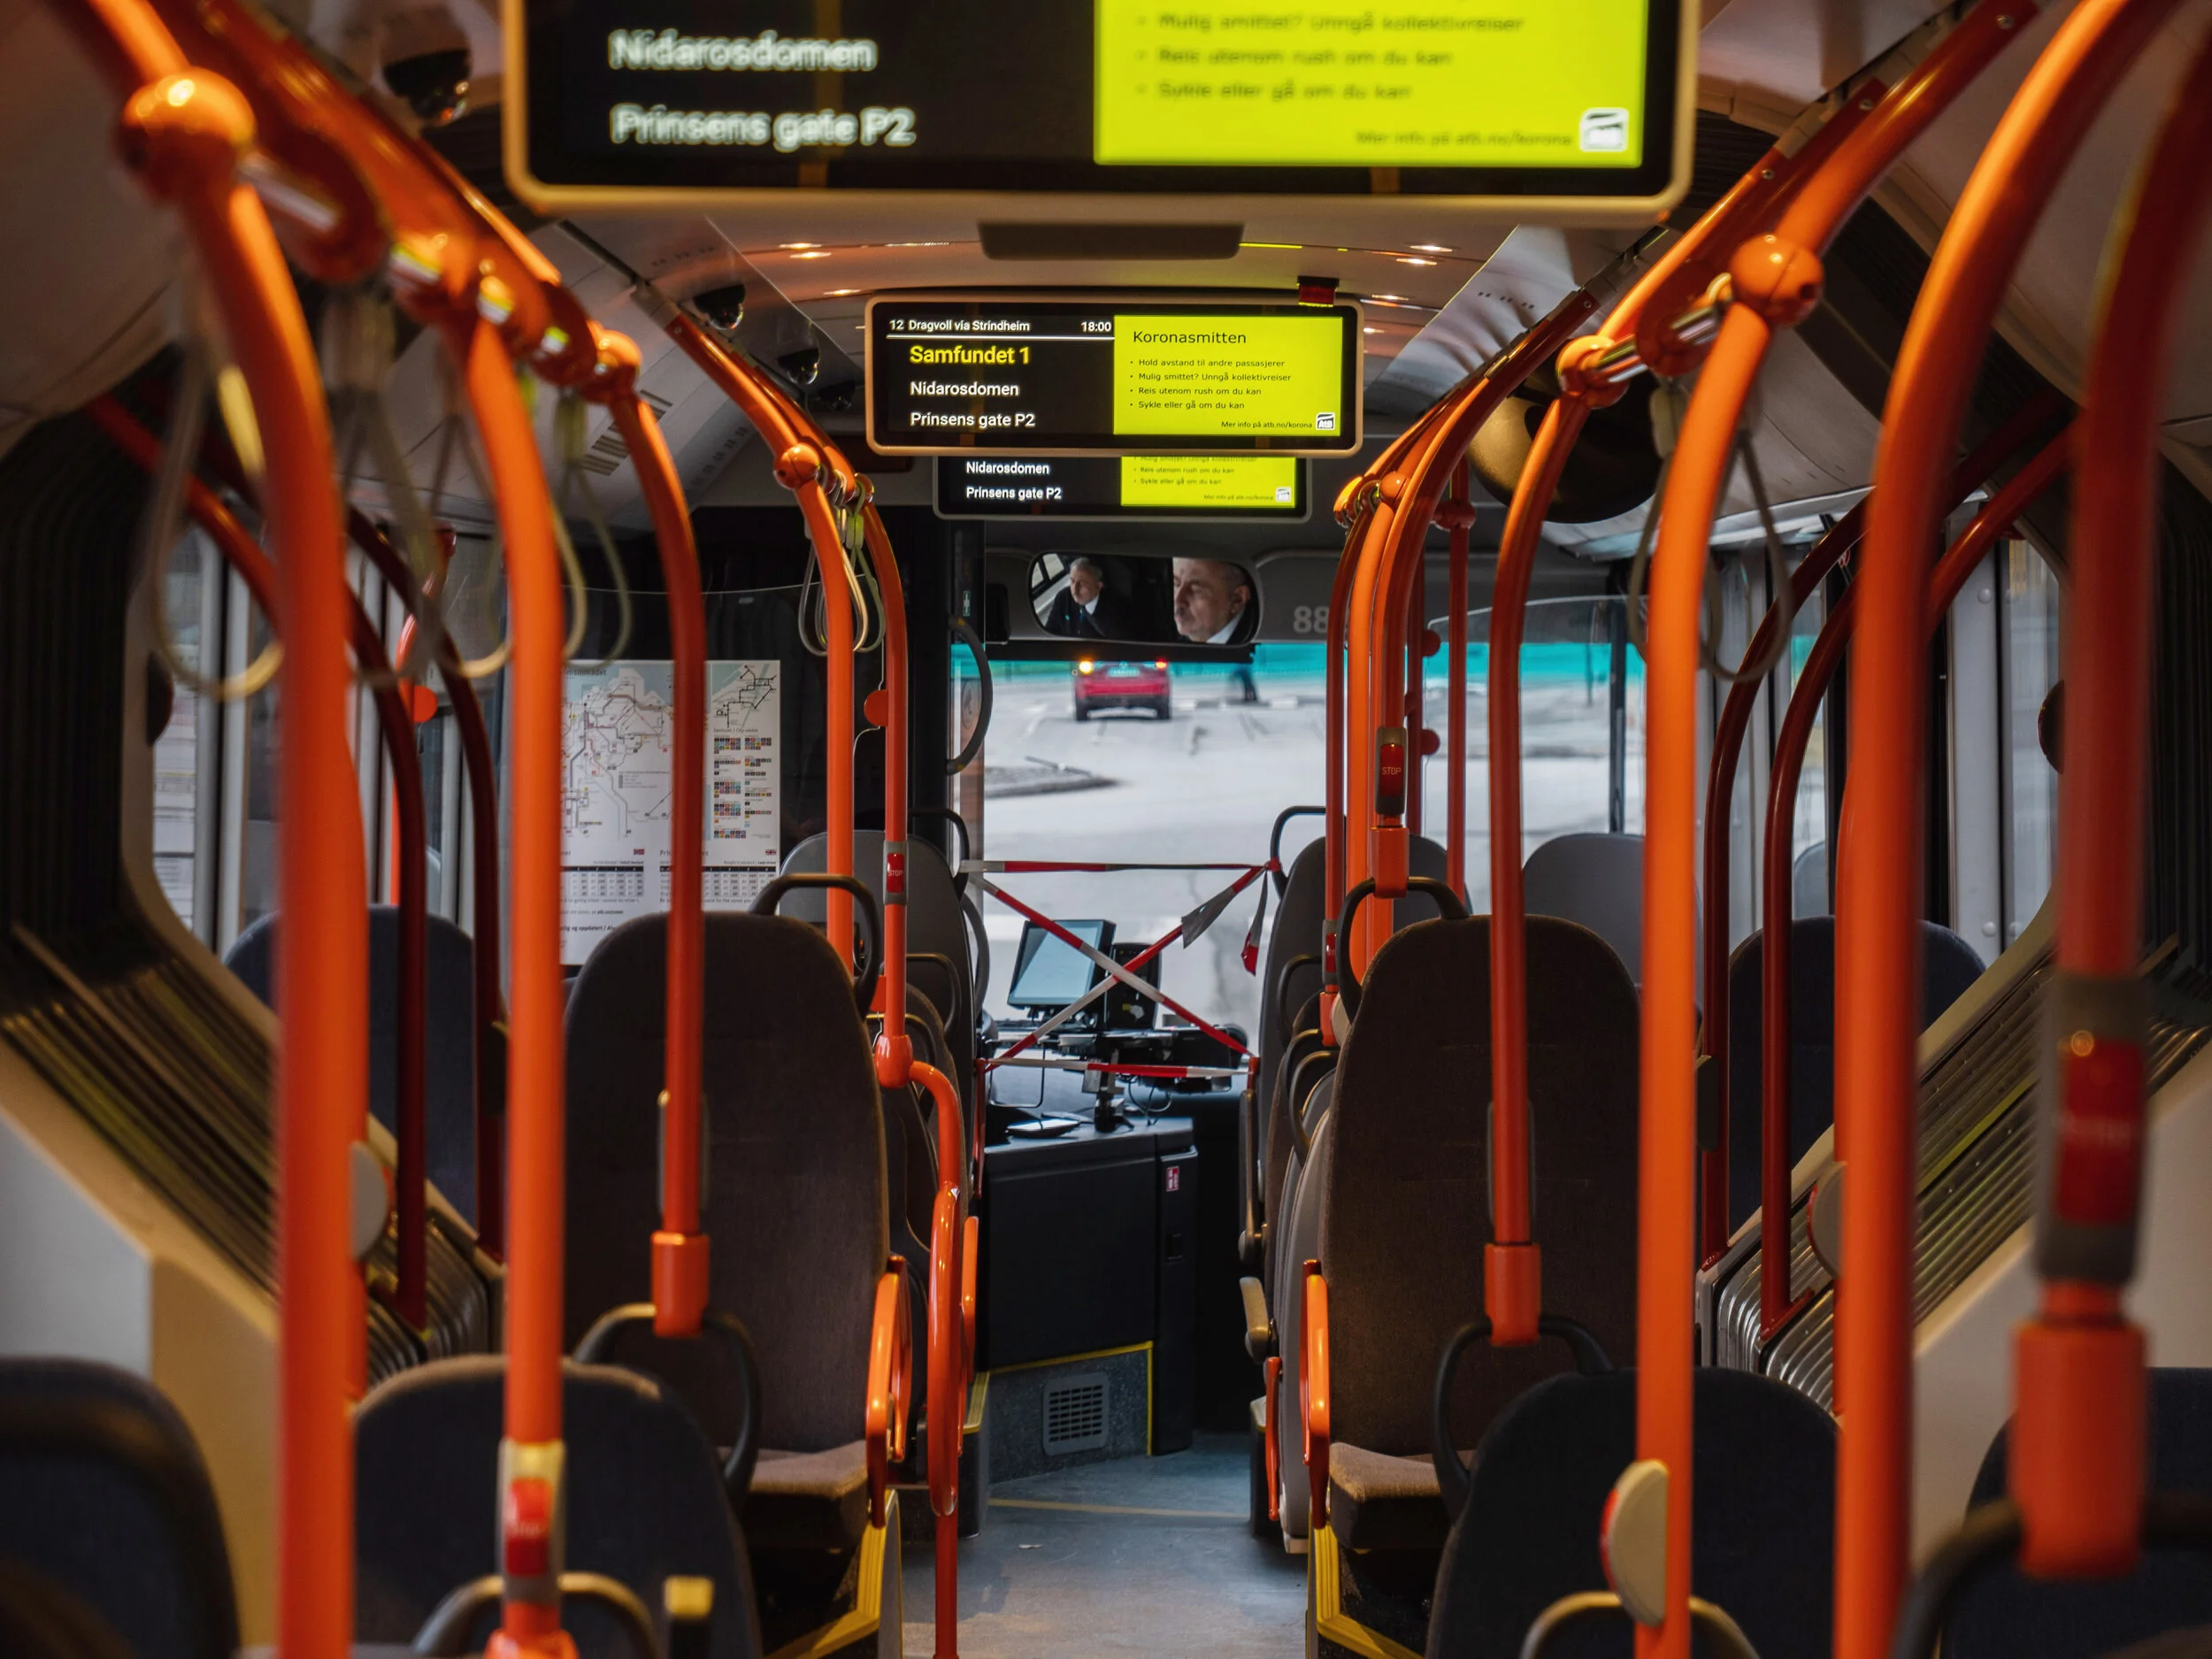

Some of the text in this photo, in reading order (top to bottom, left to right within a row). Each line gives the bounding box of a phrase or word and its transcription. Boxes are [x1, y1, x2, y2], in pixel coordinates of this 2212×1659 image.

[610, 30, 878, 70] Nidarosdomen
[1415, 50, 1450, 65] kan
[1271, 80, 1295, 102] gå
[1375, 85, 1409, 100] kan
[611, 104, 915, 151] Prinsens gate P2
[889, 319, 1031, 333] 12 Dragvoll via Strindheim
[1080, 321, 1112, 333] 18:00
[1133, 330, 1247, 344] Koronasmitten
[909, 344, 1030, 365] Samfundet 1
[1160, 358, 1194, 367] avstand
[1196, 358, 1205, 367] til
[1235, 359, 1285, 369] passasjerer
[1138, 371, 1291, 382] Mulig smittet? Unngå kollektivreiser
[910, 380, 1019, 396] Nidarosdomen
[1158, 387, 1192, 396] utenom
[1194, 387, 1213, 396] rush
[1232, 387, 1243, 396] du
[1138, 400, 1162, 411] Sykle
[1164, 400, 1183, 409] eller
[1185, 399, 1196, 411] gå
[1228, 401, 1245, 410] kan
[910, 411, 1036, 429] Prinsens gate P2
[1252, 420, 1262, 430] på
[1263, 420, 1313, 430] atb.no/korona
[965, 460, 1050, 475] Nidarosdomen
[1176, 477, 1185, 486] gå
[965, 485, 1062, 502] Prinsens gate P2
[1381, 766, 1402, 775] STOP
